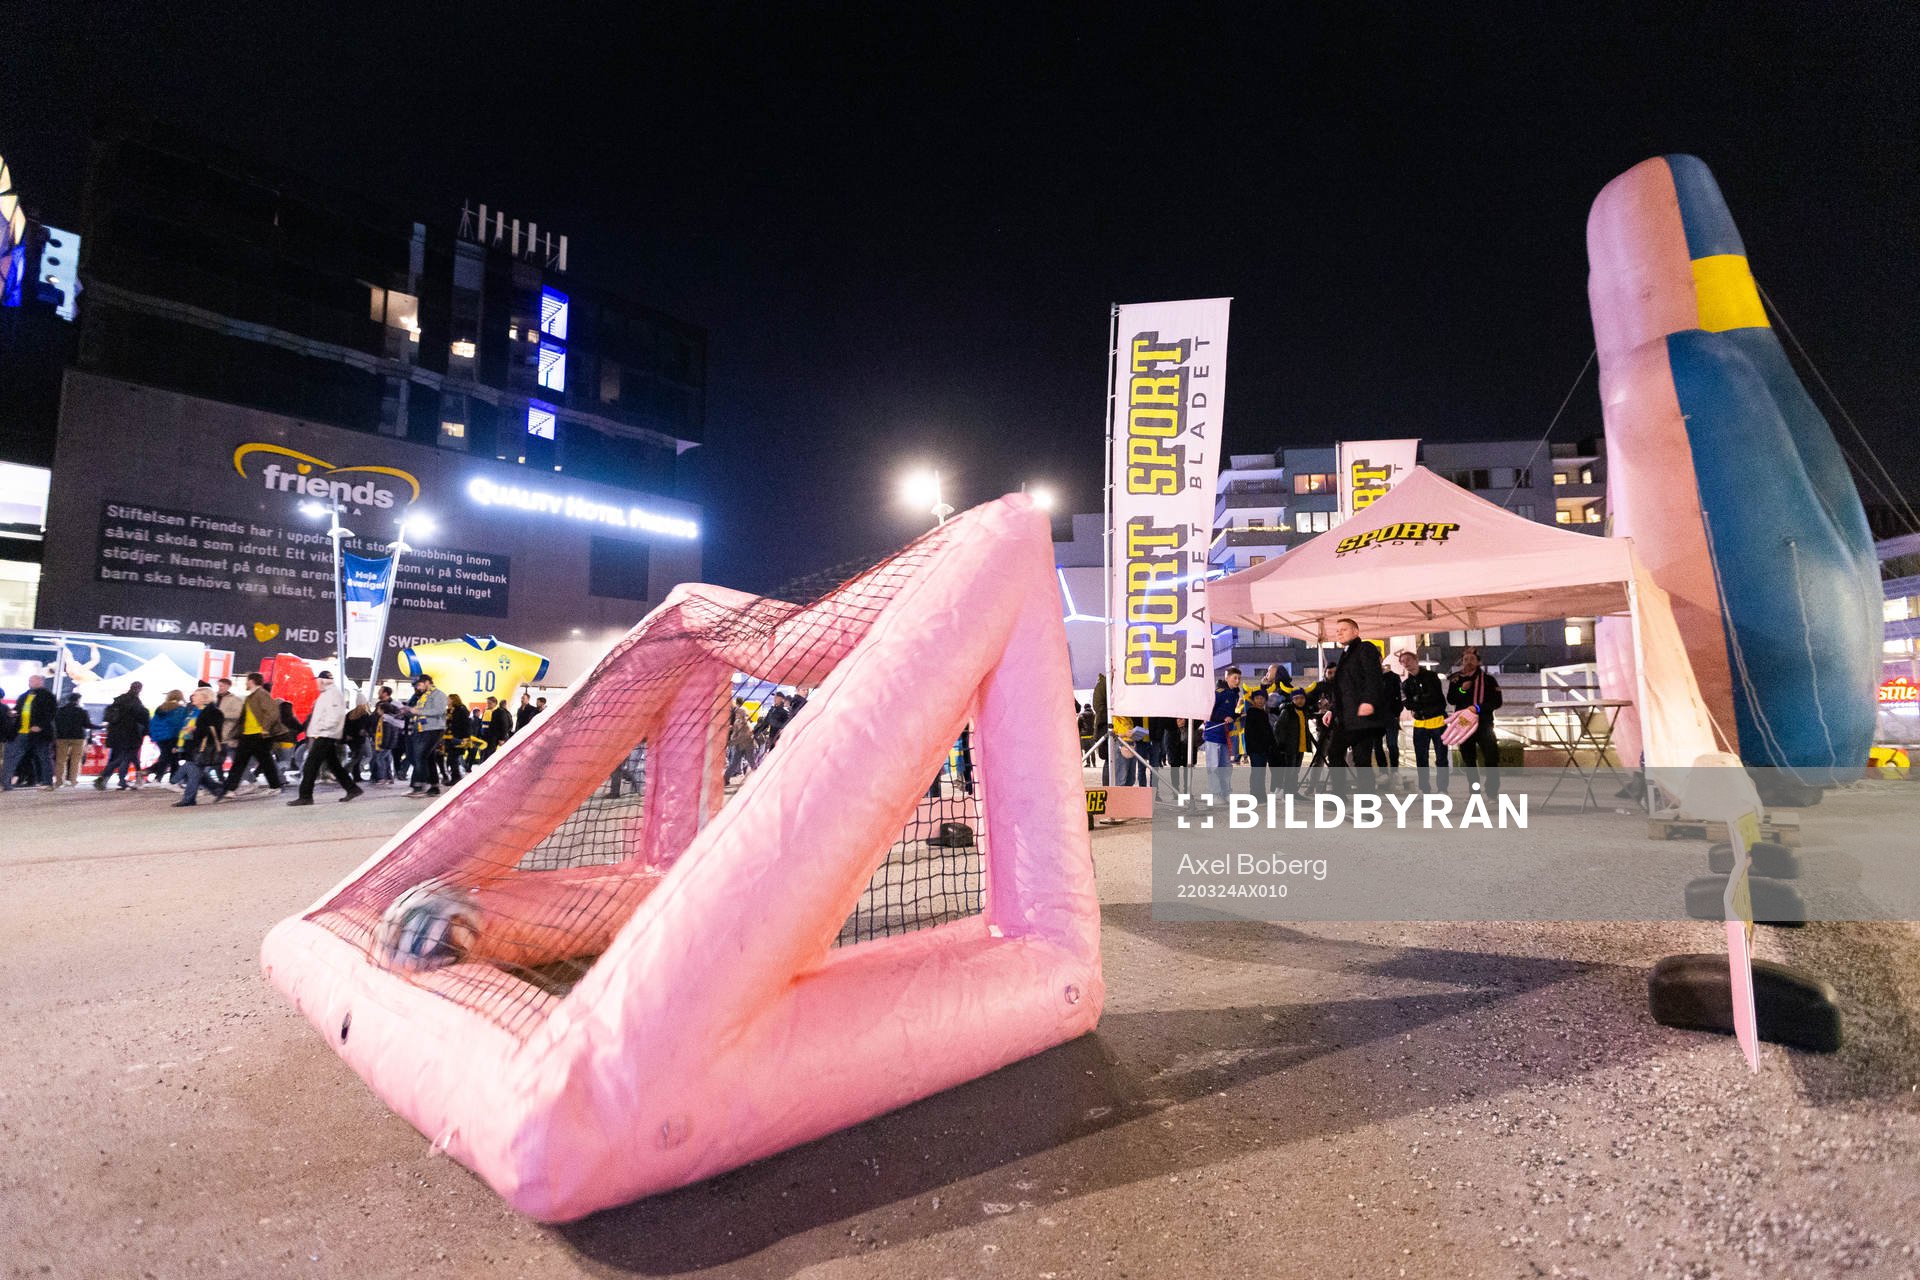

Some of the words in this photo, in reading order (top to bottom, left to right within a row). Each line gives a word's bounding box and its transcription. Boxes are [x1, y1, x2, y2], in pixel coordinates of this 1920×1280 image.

[1127, 331, 1192, 496] SPORT
[1190, 335, 1210, 489] BLADET
[263, 464, 394, 509] friends
[104, 526, 150, 542] såväl
[155, 532, 198, 548] skola
[203, 540, 234, 552] som
[286, 547, 305, 560] Ett
[310, 551, 345, 568] viktg
[397, 563, 420, 575] som
[425, 565, 435, 576] vi
[438, 567, 452, 579] på
[455, 568, 507, 584] Swedbank
[106, 504, 185, 527] Stiftelsen
[190, 516, 245, 535] Friends
[250, 524, 274, 538] har
[278, 528, 283, 539] i
[287, 531, 333, 545] uppdra
[344, 538, 362, 550] att
[410, 548, 462, 566] mobbning
[466, 553, 491, 567] inom
[1335, 522, 1461, 554] SPORT
[1336, 540, 1445, 559] BLADET
[101, 566, 139, 581] barn
[143, 571, 173, 584] ska
[178, 574, 232, 590] behöva
[236, 581, 268, 594] vara
[272, 583, 317, 600] utsatt,
[169, 552, 228, 570] Namnet
[232, 561, 251, 574] på
[255, 563, 297, 578] denna
[394, 579, 443, 593] minnelse
[446, 585, 462, 595] att
[466, 586, 491, 599] inget
[1124, 515, 1189, 687] SPORT
[1190, 523, 1207, 679] BLADET
[98, 614, 182, 634] FRIENDS
[186, 621, 248, 638] ARENA
[285, 627, 320, 643] MED
[473, 670, 496, 692] 10
[1085, 790, 1108, 815] GE
